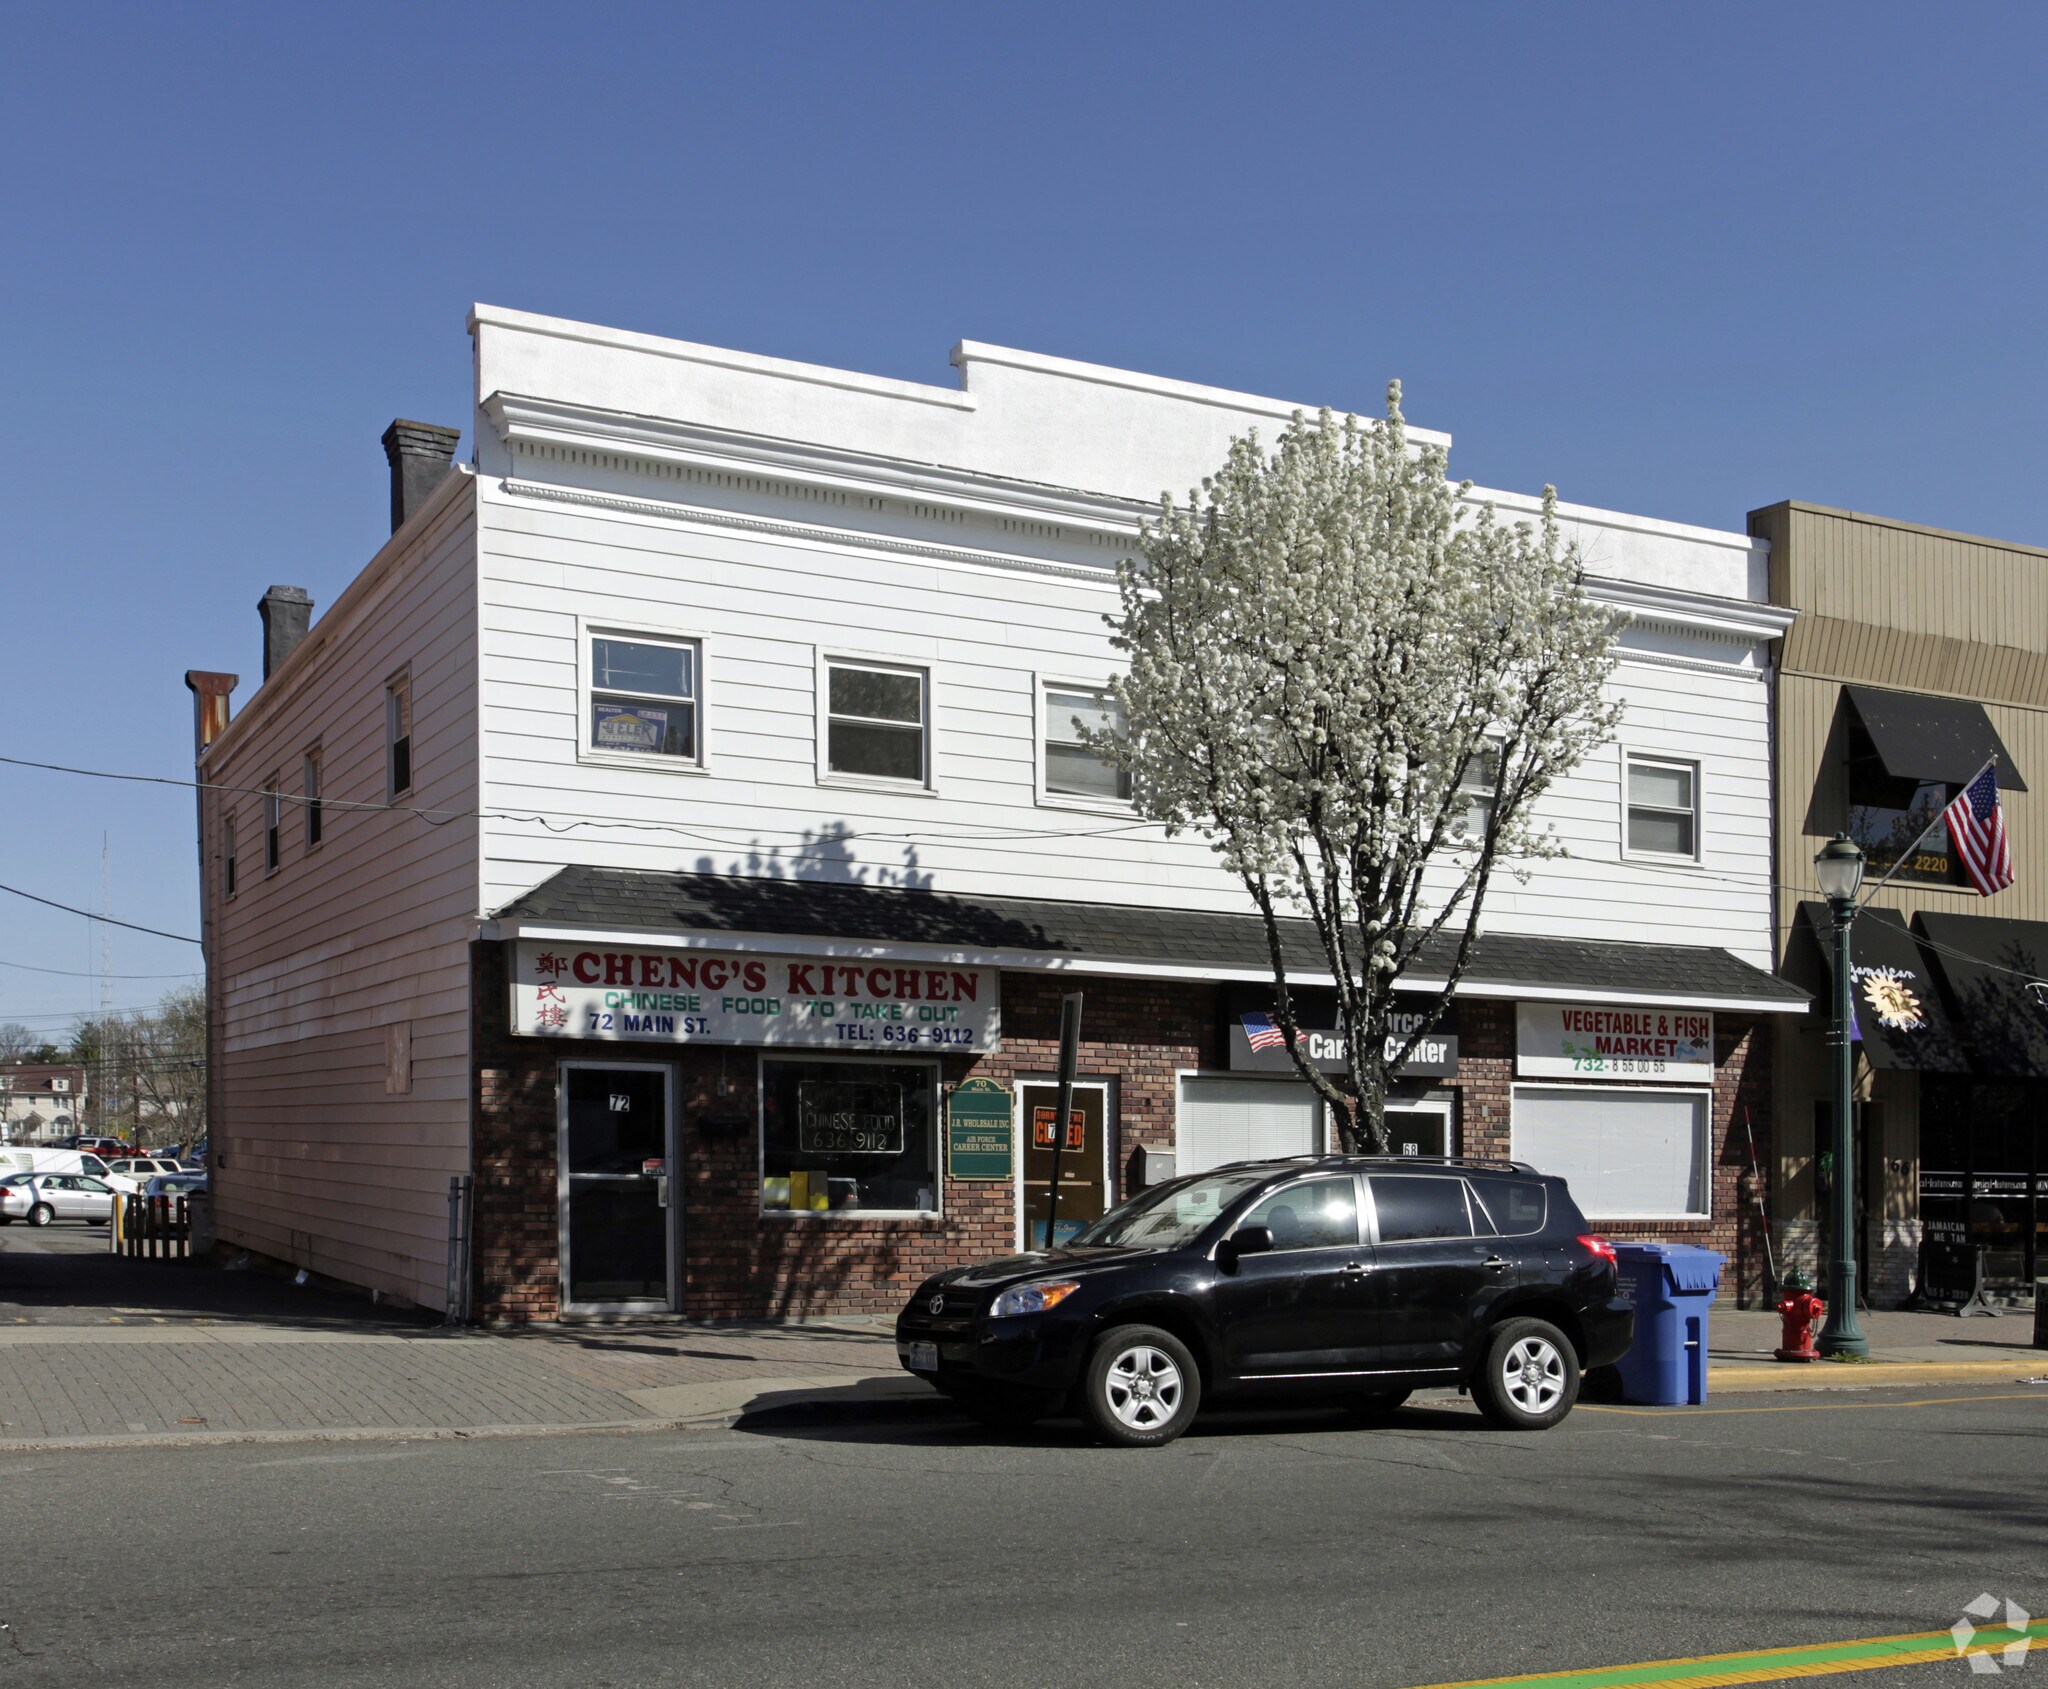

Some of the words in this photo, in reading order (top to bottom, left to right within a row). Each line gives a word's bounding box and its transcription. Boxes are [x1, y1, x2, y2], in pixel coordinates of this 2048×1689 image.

[639, 711, 666, 720] LEASE
[1914, 856, 1948, 873] 2220
[572, 952, 767, 993] CHENG'S
[787, 963, 979, 1002] KITCHEN
[605, 991, 701, 1013] CHINESE
[722, 997, 781, 1016] FOOD
[807, 1001, 835, 1018] TO
[851, 1003, 902, 1021] TAKE
[918, 1006, 959, 1022] OUT
[589, 1013, 613, 1030] 72
[624, 1014, 674, 1033] MAIN
[684, 1017, 711, 1035] ST.
[1562, 1010, 1652, 1036] VEGETABLE
[1657, 1015, 1668, 1036] &
[1675, 1016, 1709, 1038] FISH
[836, 1024, 874, 1041] TEL:
[883, 1025, 974, 1044] 636-9112
[1595, 1036, 1678, 1057] MARKET
[611, 1095, 629, 1111] 72
[805, 1112, 860, 1130] CHINESE
[963, 1119, 998, 1128] WHOLESALE
[999, 1120, 1010, 1128] INC.
[1036, 1111, 1057, 1120] SORR
[814, 1131, 846, 1148] 636
[856, 1132, 886, 1149] 9112
[954, 1143, 980, 1151] CAREER
[981, 1143, 1008, 1151] CENTER
[1404, 1144, 1416, 1156] 68
[1928, 1221, 1965, 1232] JAMAICAN
[1934, 1232, 1945, 1242] ME
[1951, 1233, 1966, 1243] TAN
